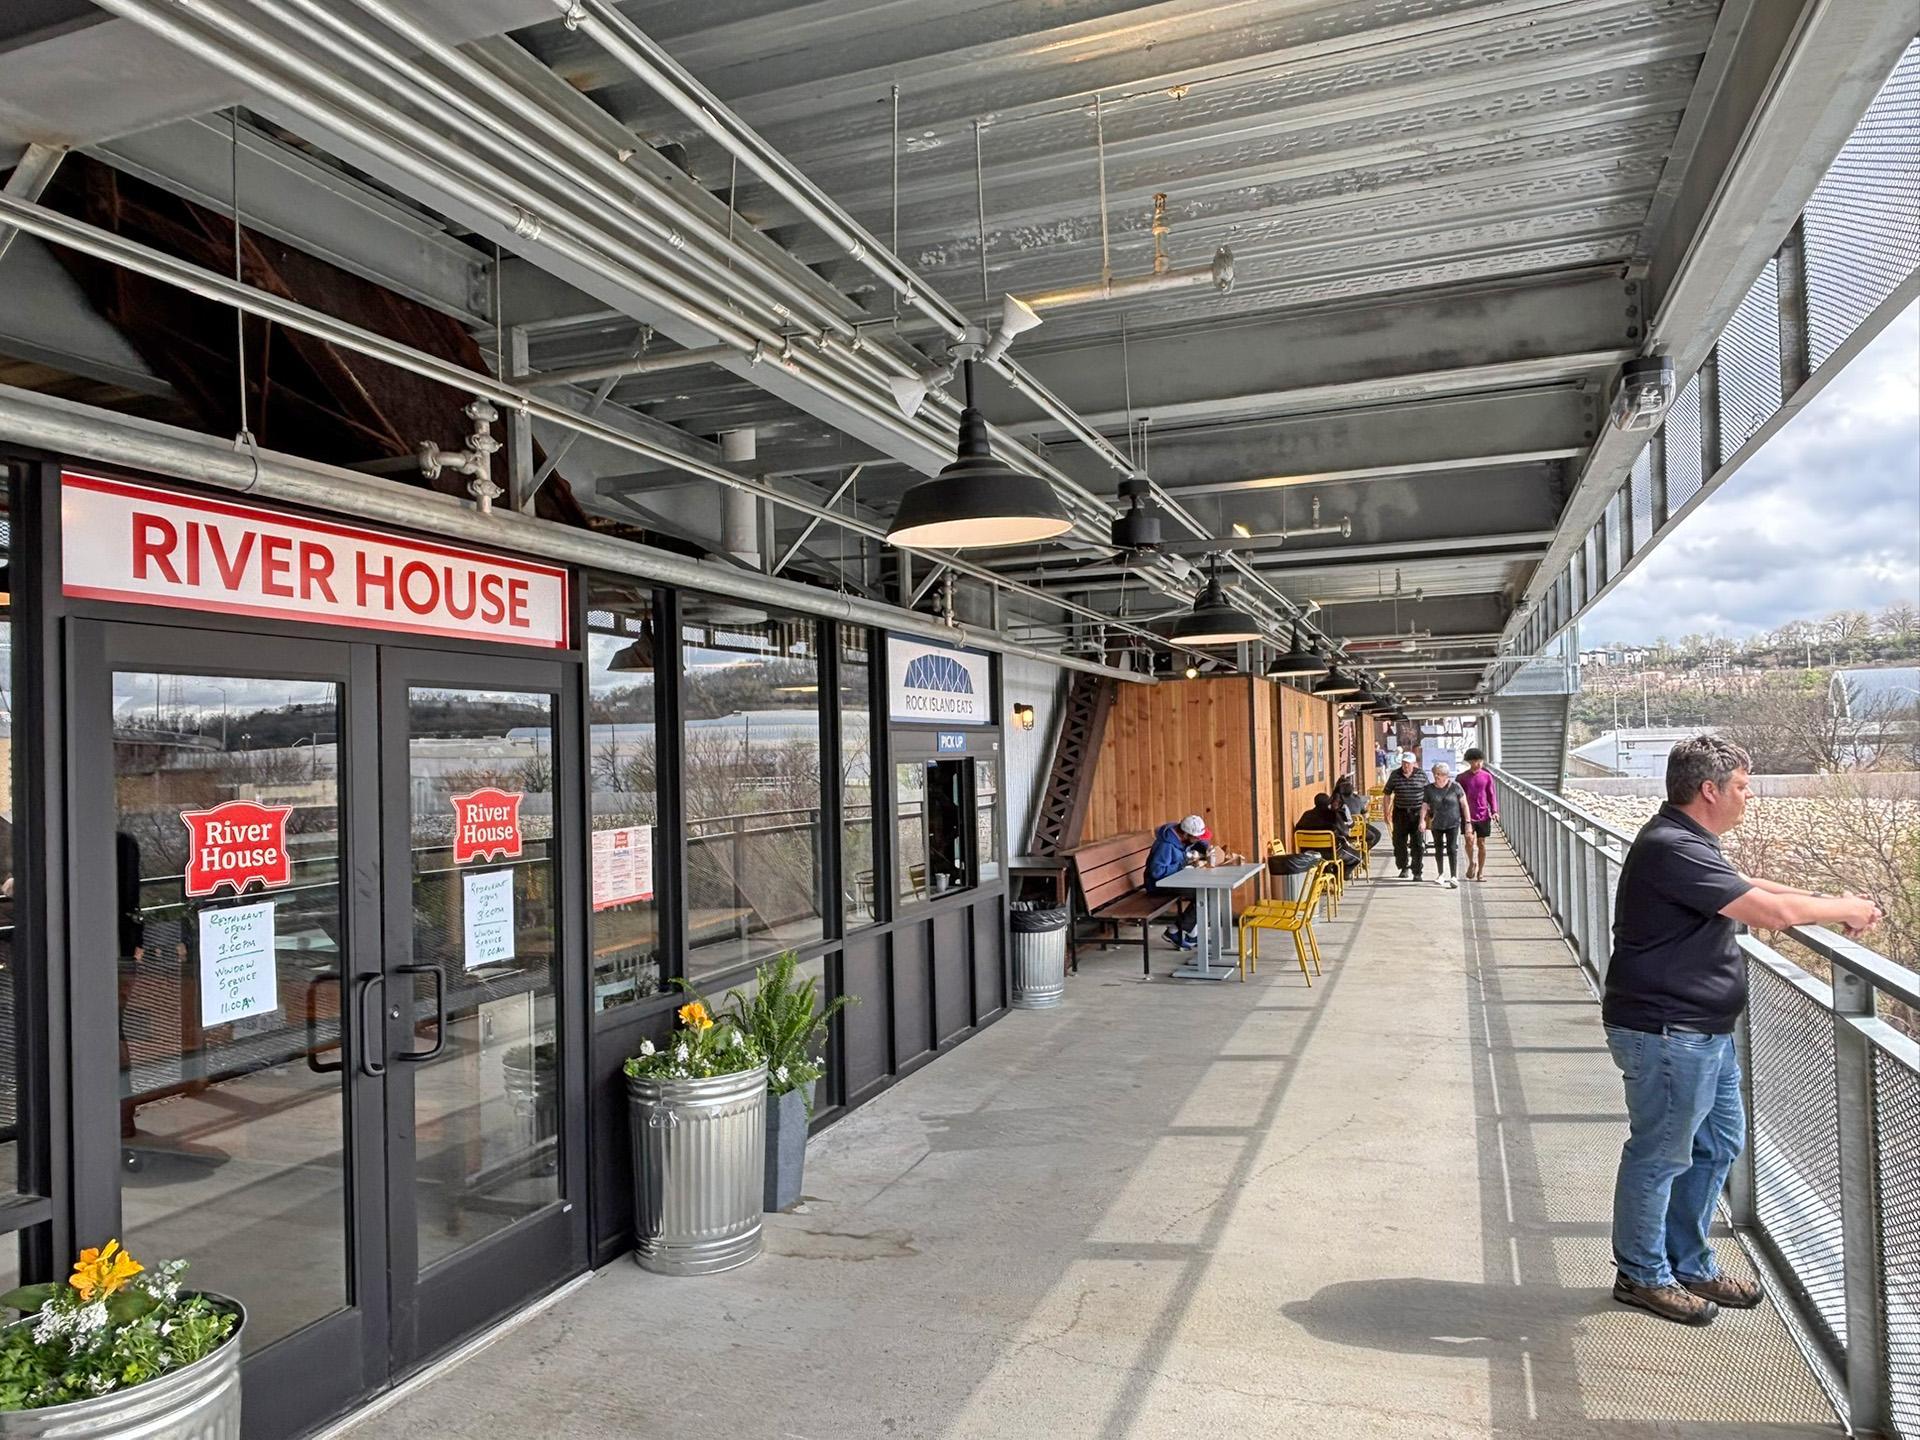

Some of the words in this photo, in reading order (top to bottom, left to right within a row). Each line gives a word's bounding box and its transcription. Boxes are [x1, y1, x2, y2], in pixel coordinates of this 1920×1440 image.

[132, 511, 339, 604] RIVER
[355, 550, 531, 628] HOUSE
[905, 694, 928, 711] ROCK
[929, 697, 955, 713] ISLAND
[956, 700, 974, 714] EATS
[940, 735, 955, 749] PICK
[955, 735, 964, 749] UP
[466, 803, 511, 823] River
[205, 820, 273, 845] River
[463, 824, 514, 844] House
[200, 847, 278, 872] House
